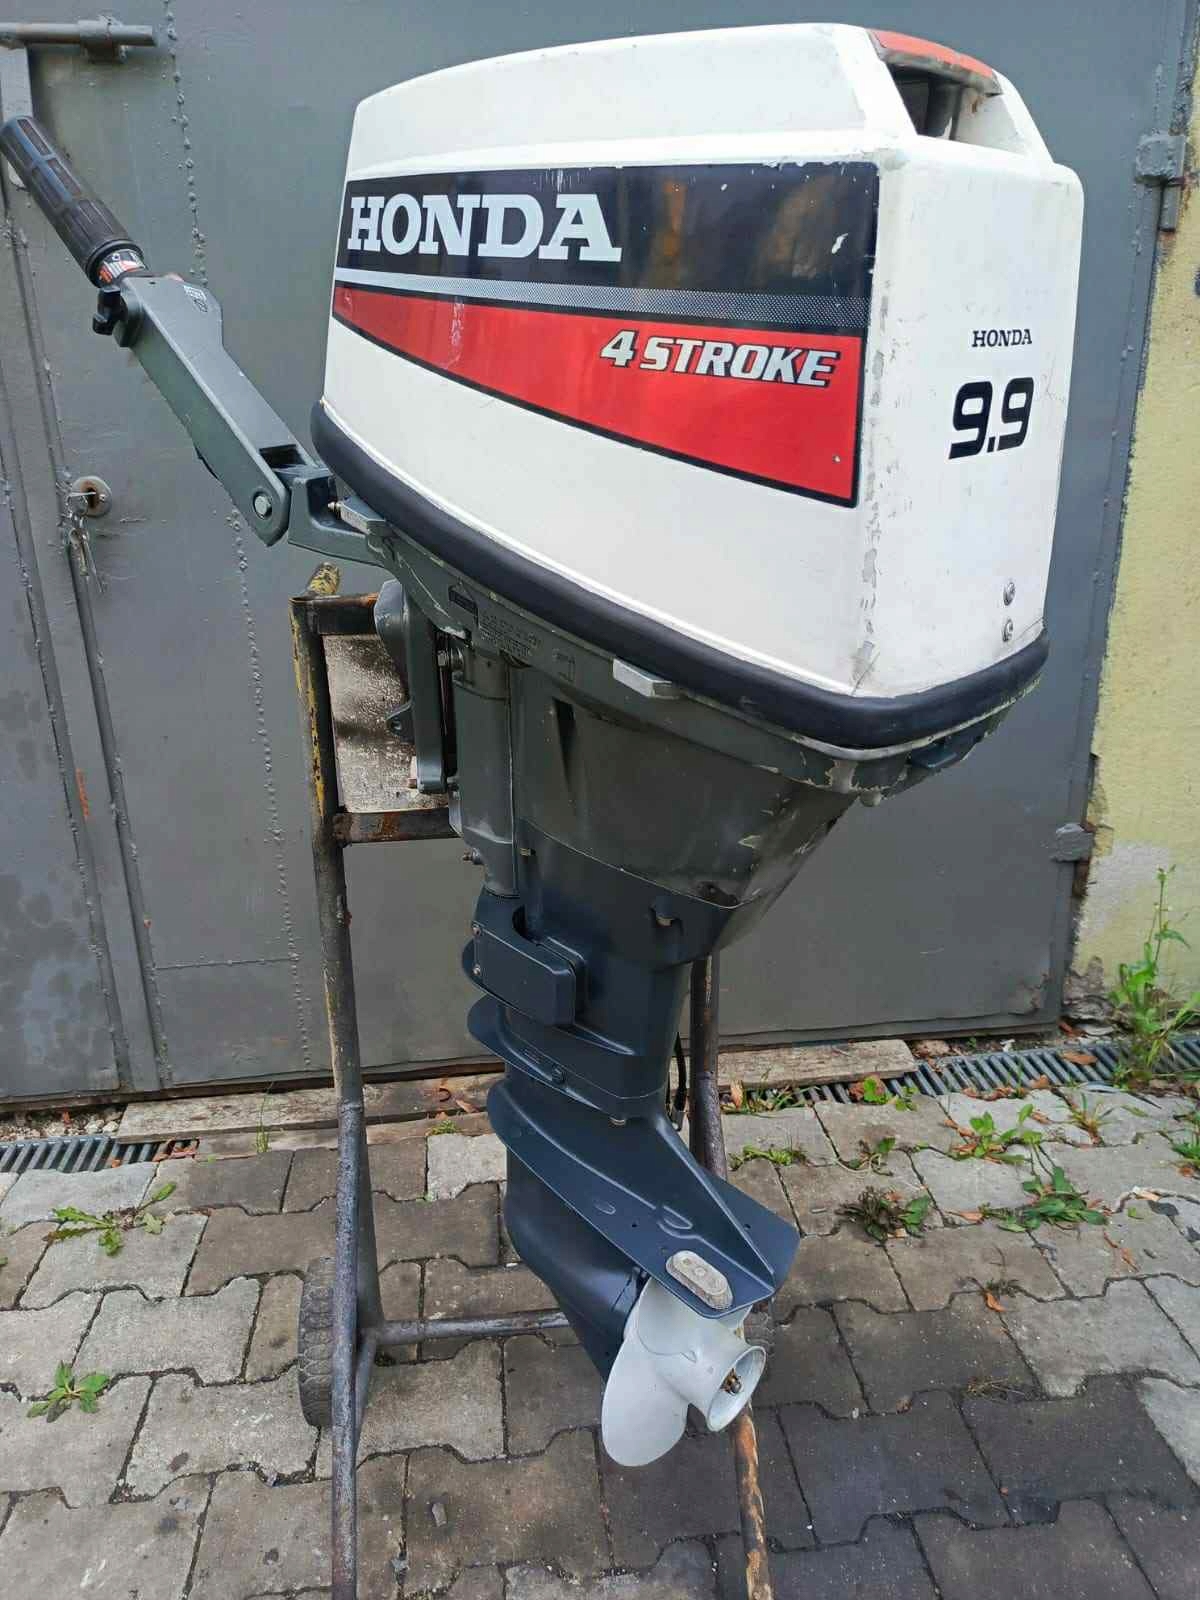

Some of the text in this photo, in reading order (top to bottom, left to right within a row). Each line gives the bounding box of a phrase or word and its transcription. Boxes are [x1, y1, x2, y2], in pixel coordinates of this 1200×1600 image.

[347, 193, 623, 262] HONDA
[600, 328, 841, 388] 4 STROKE
[971, 328, 1033, 348] HONDA
[947, 376, 1035, 460] 9.9
